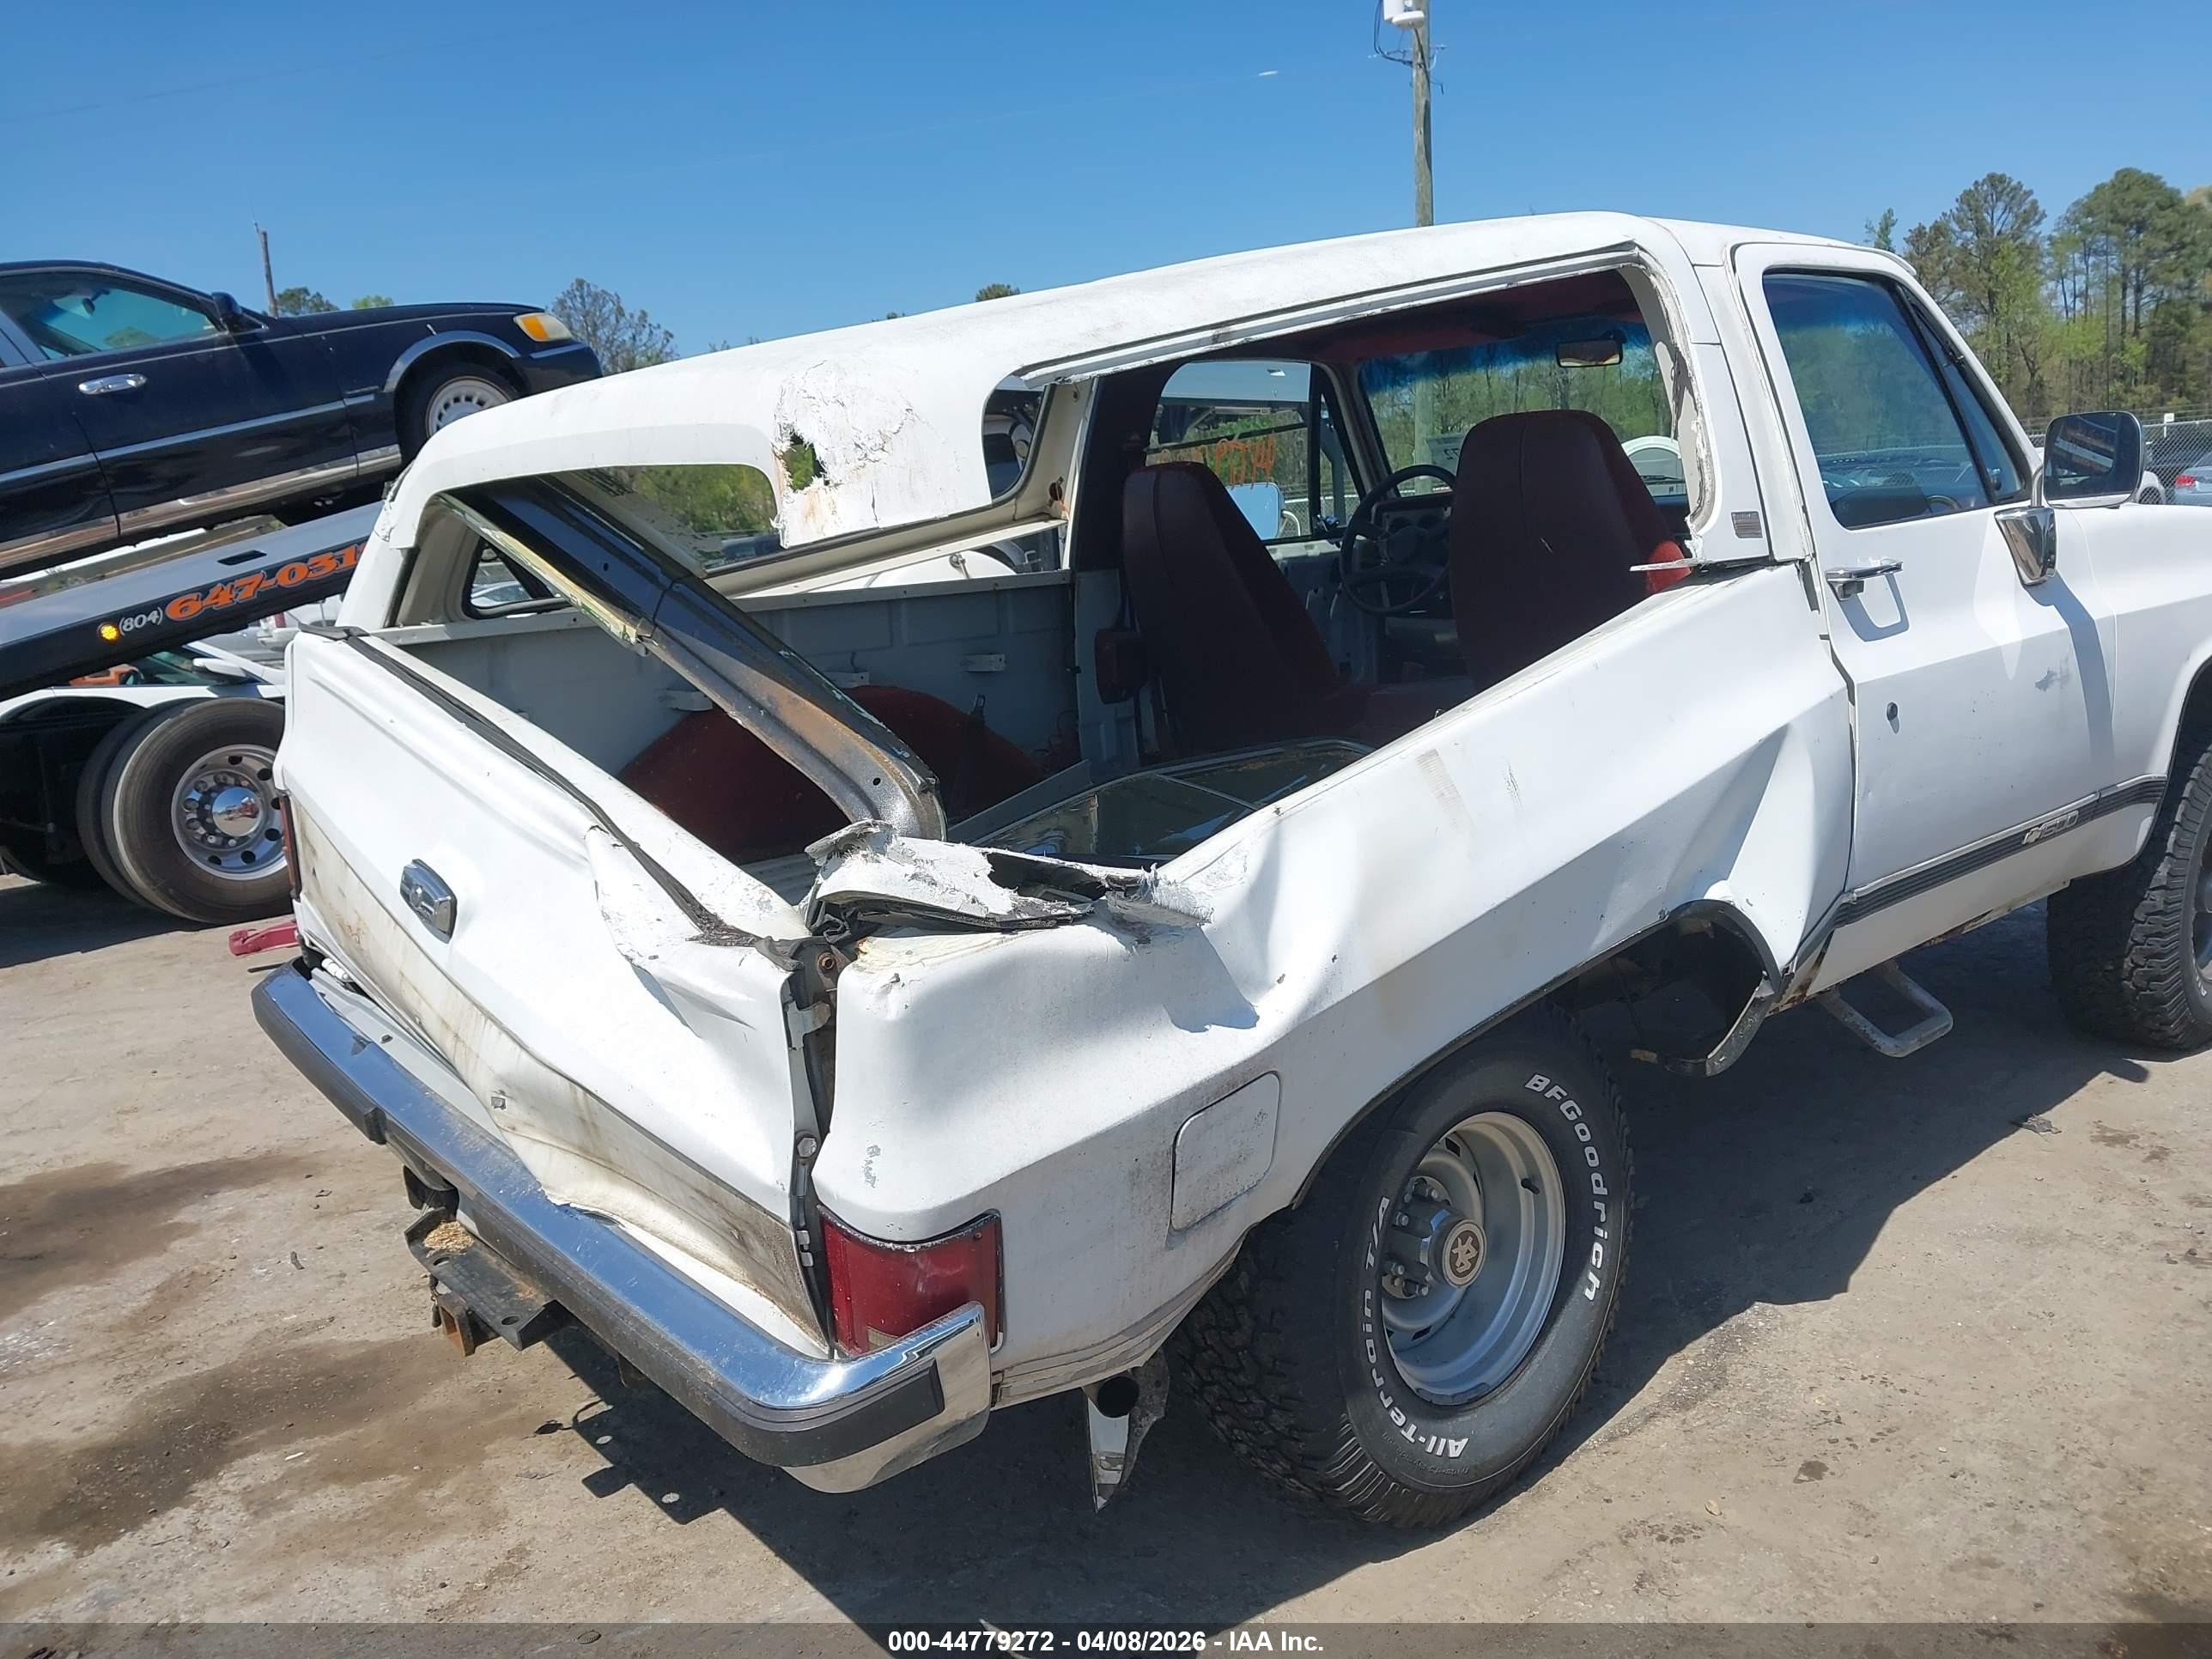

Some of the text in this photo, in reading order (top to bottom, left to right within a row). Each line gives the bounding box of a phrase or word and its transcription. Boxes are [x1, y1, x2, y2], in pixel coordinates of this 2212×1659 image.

[119, 542, 367, 635] (804) 647-031
[1524, 1073, 1608, 1302] BFGoodrich
[1362, 1290, 1469, 1458] All-Terrain
